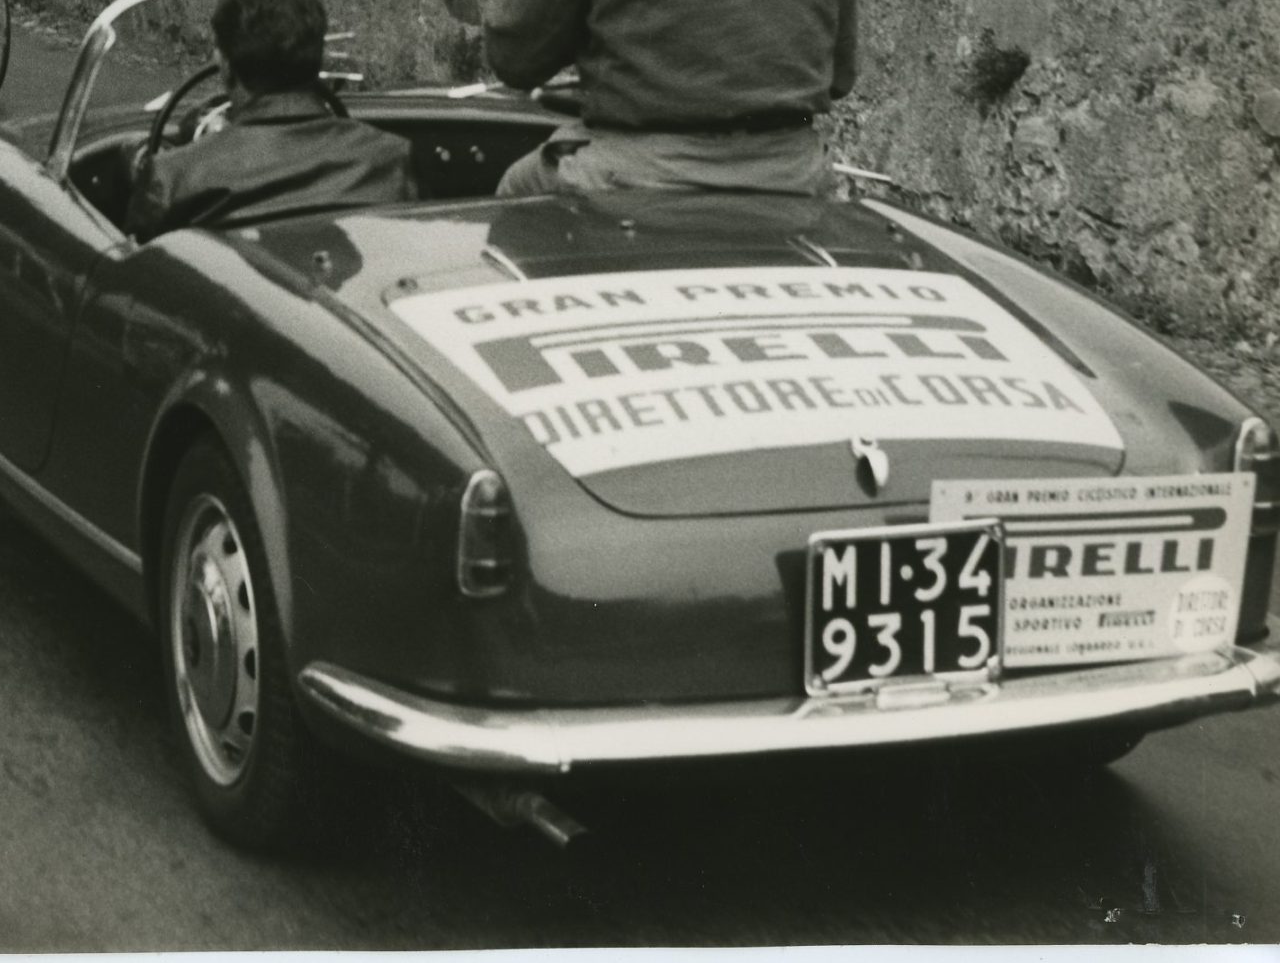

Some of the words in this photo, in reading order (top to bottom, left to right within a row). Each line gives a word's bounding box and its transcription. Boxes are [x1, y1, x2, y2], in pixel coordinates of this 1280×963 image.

[453, 289, 647, 324] GRAN
[675, 282, 947, 303] PREMIO
[473, 314, 1010, 393] PIRELLI
[520, 376, 854, 445] DIRETTORE
[879, 374, 1088, 415] CORSA
[986, 490, 1019, 504] GRAN
[1027, 488, 1069, 504] PREMIO
[1004, 538, 1215, 579] IRELLI
[1008, 593, 1122, 611] ORGANIZZAZIONE
[821, 605, 991, 682] 9315
[1013, 616, 1083, 633] SPORTIVO
